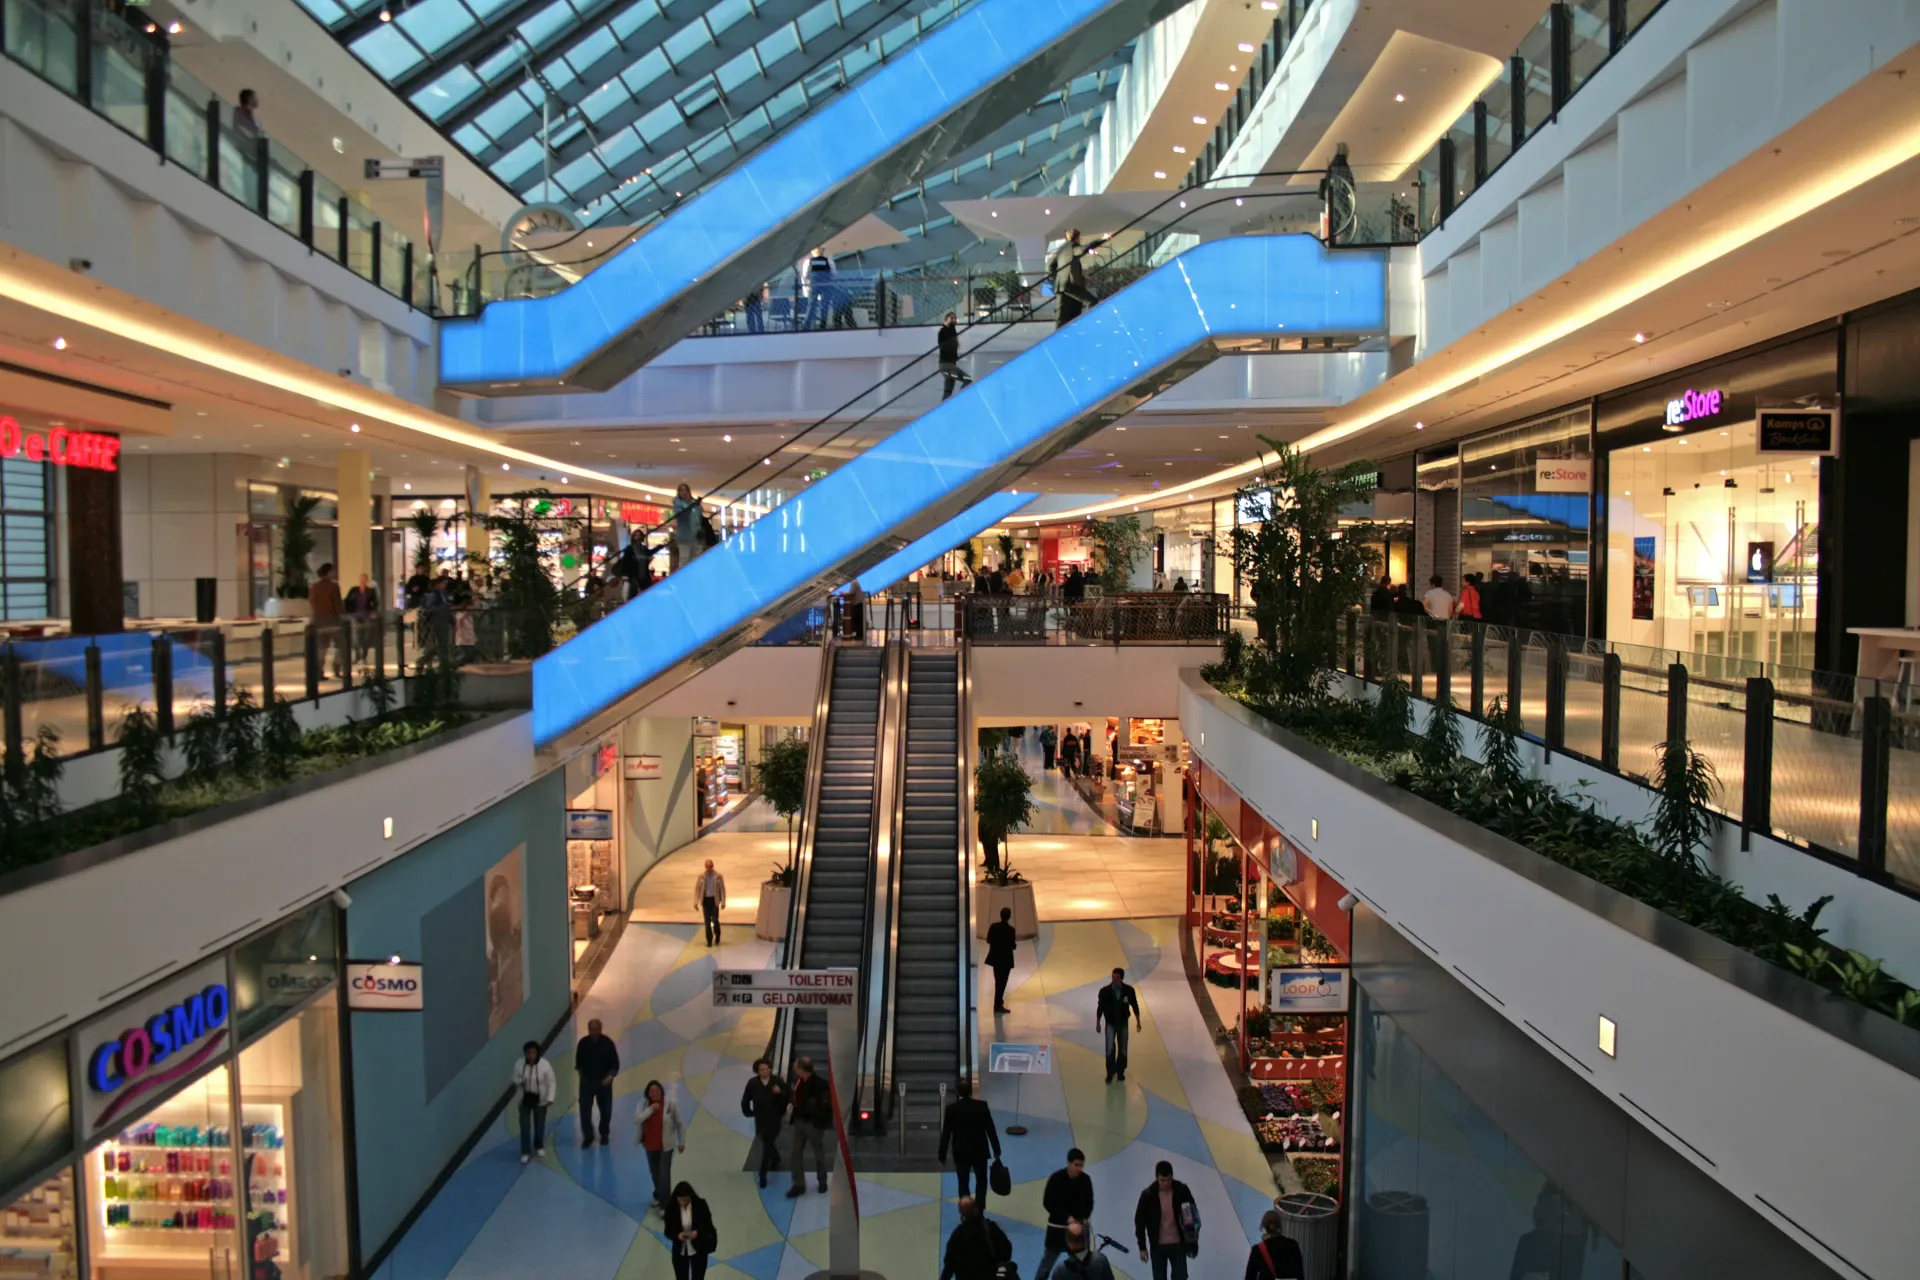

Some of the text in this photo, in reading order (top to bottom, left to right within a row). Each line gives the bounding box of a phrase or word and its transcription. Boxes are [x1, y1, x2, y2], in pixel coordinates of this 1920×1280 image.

[1667, 389, 1722, 425] re:Store
[1540, 469, 1587, 480] re:Store
[352, 976, 417, 991] COSMO
[788, 975, 853, 986] TOILETTEN
[762, 993, 853, 1005] GELDAUTOMAT
[88, 984, 229, 1092] COSMO
